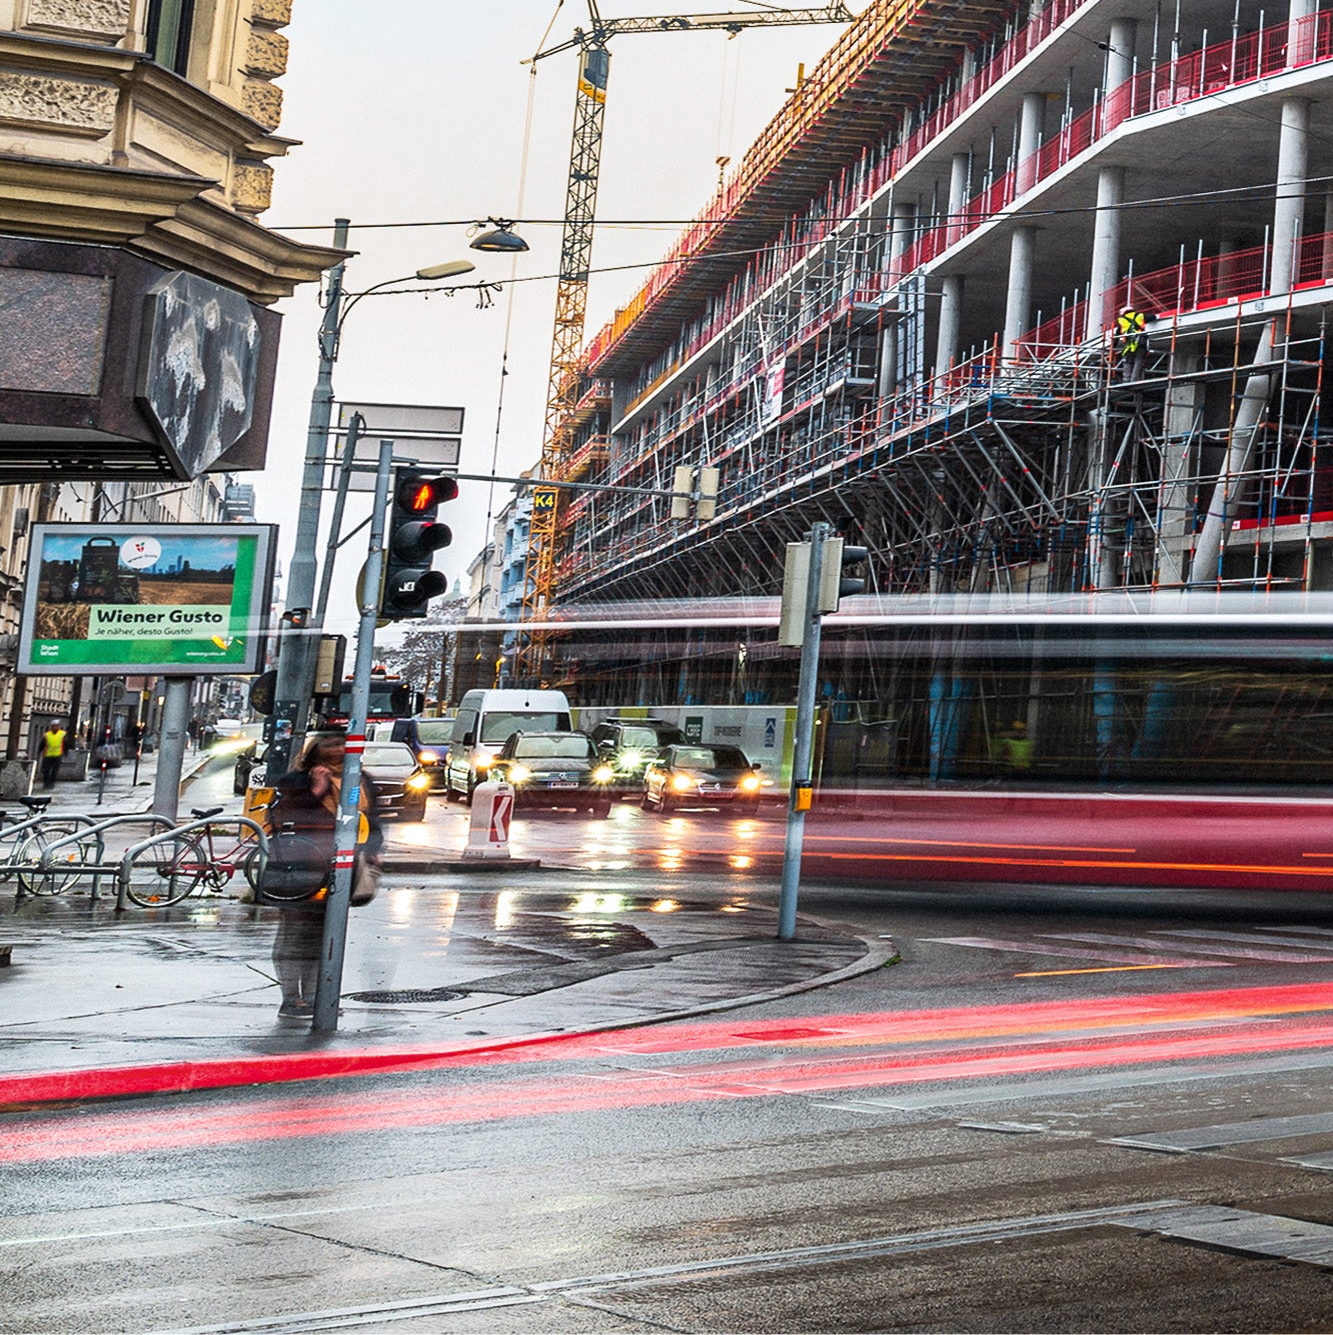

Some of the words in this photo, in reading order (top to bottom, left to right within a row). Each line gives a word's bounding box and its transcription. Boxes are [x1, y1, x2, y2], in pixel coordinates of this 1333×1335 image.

[535, 494, 554, 508] K4
[96, 609, 166, 624] Wiener
[169, 610, 224, 624] Gusto
[94, 627, 110, 636] Je
[111, 627, 136, 637] näher,
[138, 627, 163, 636] desto
[164, 627, 194, 636] Gusto!
